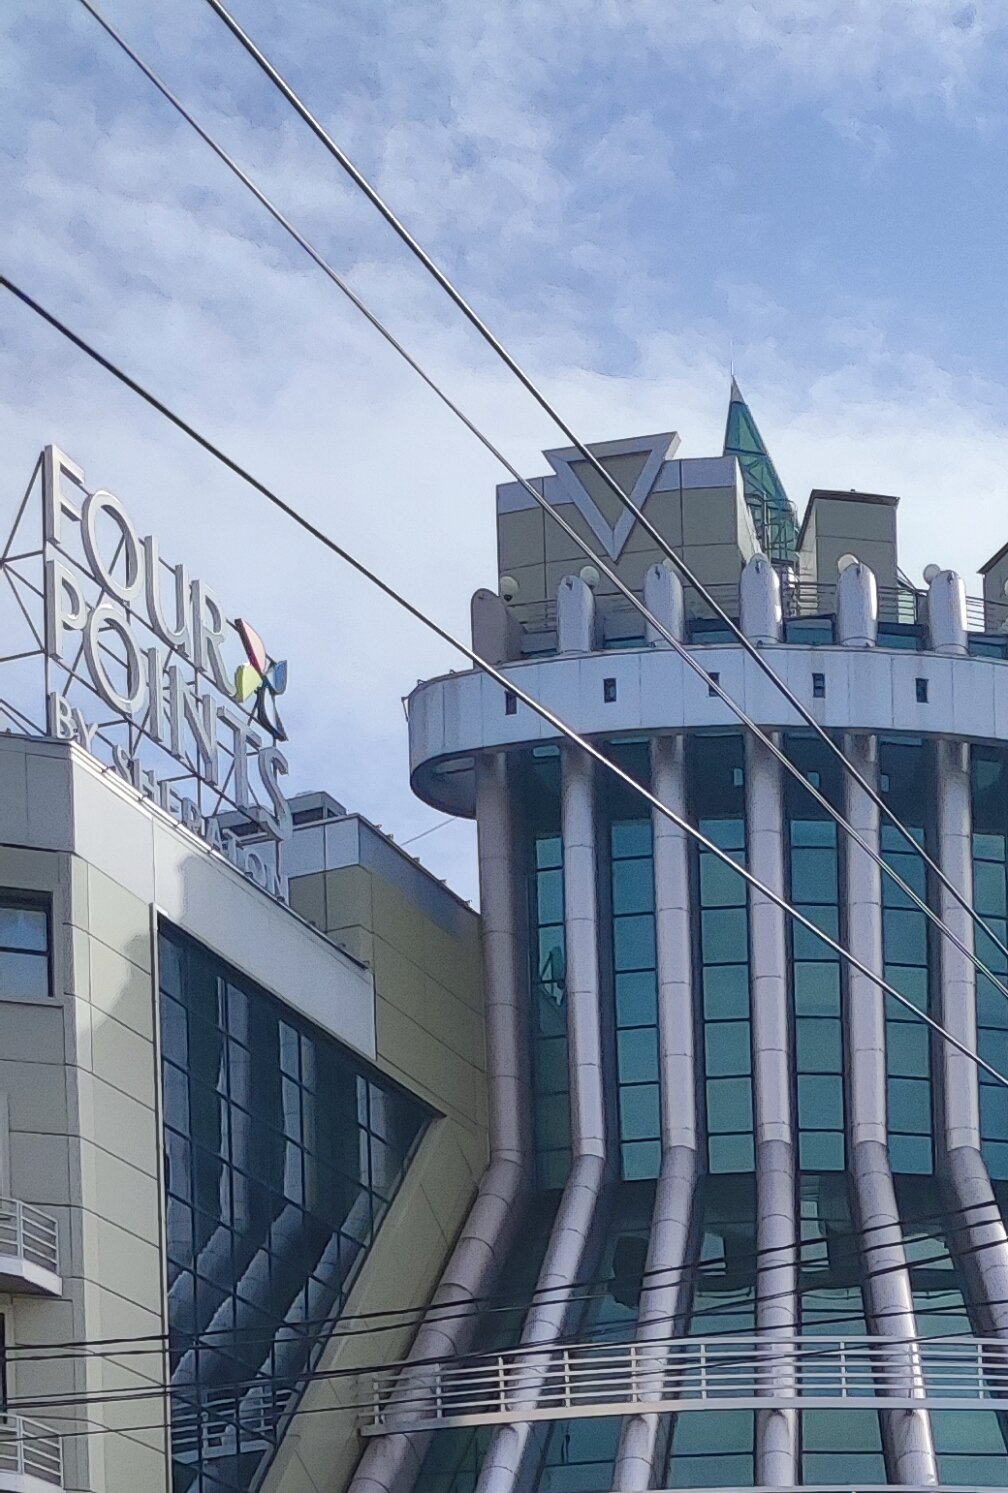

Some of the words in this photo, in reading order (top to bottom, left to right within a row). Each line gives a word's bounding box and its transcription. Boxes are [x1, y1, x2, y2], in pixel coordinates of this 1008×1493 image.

[44, 444, 238, 698] FOUR
[46, 560, 292, 840] POINTS
[51, 691, 97, 753] BY
[112, 745, 289, 904] SHERATON
